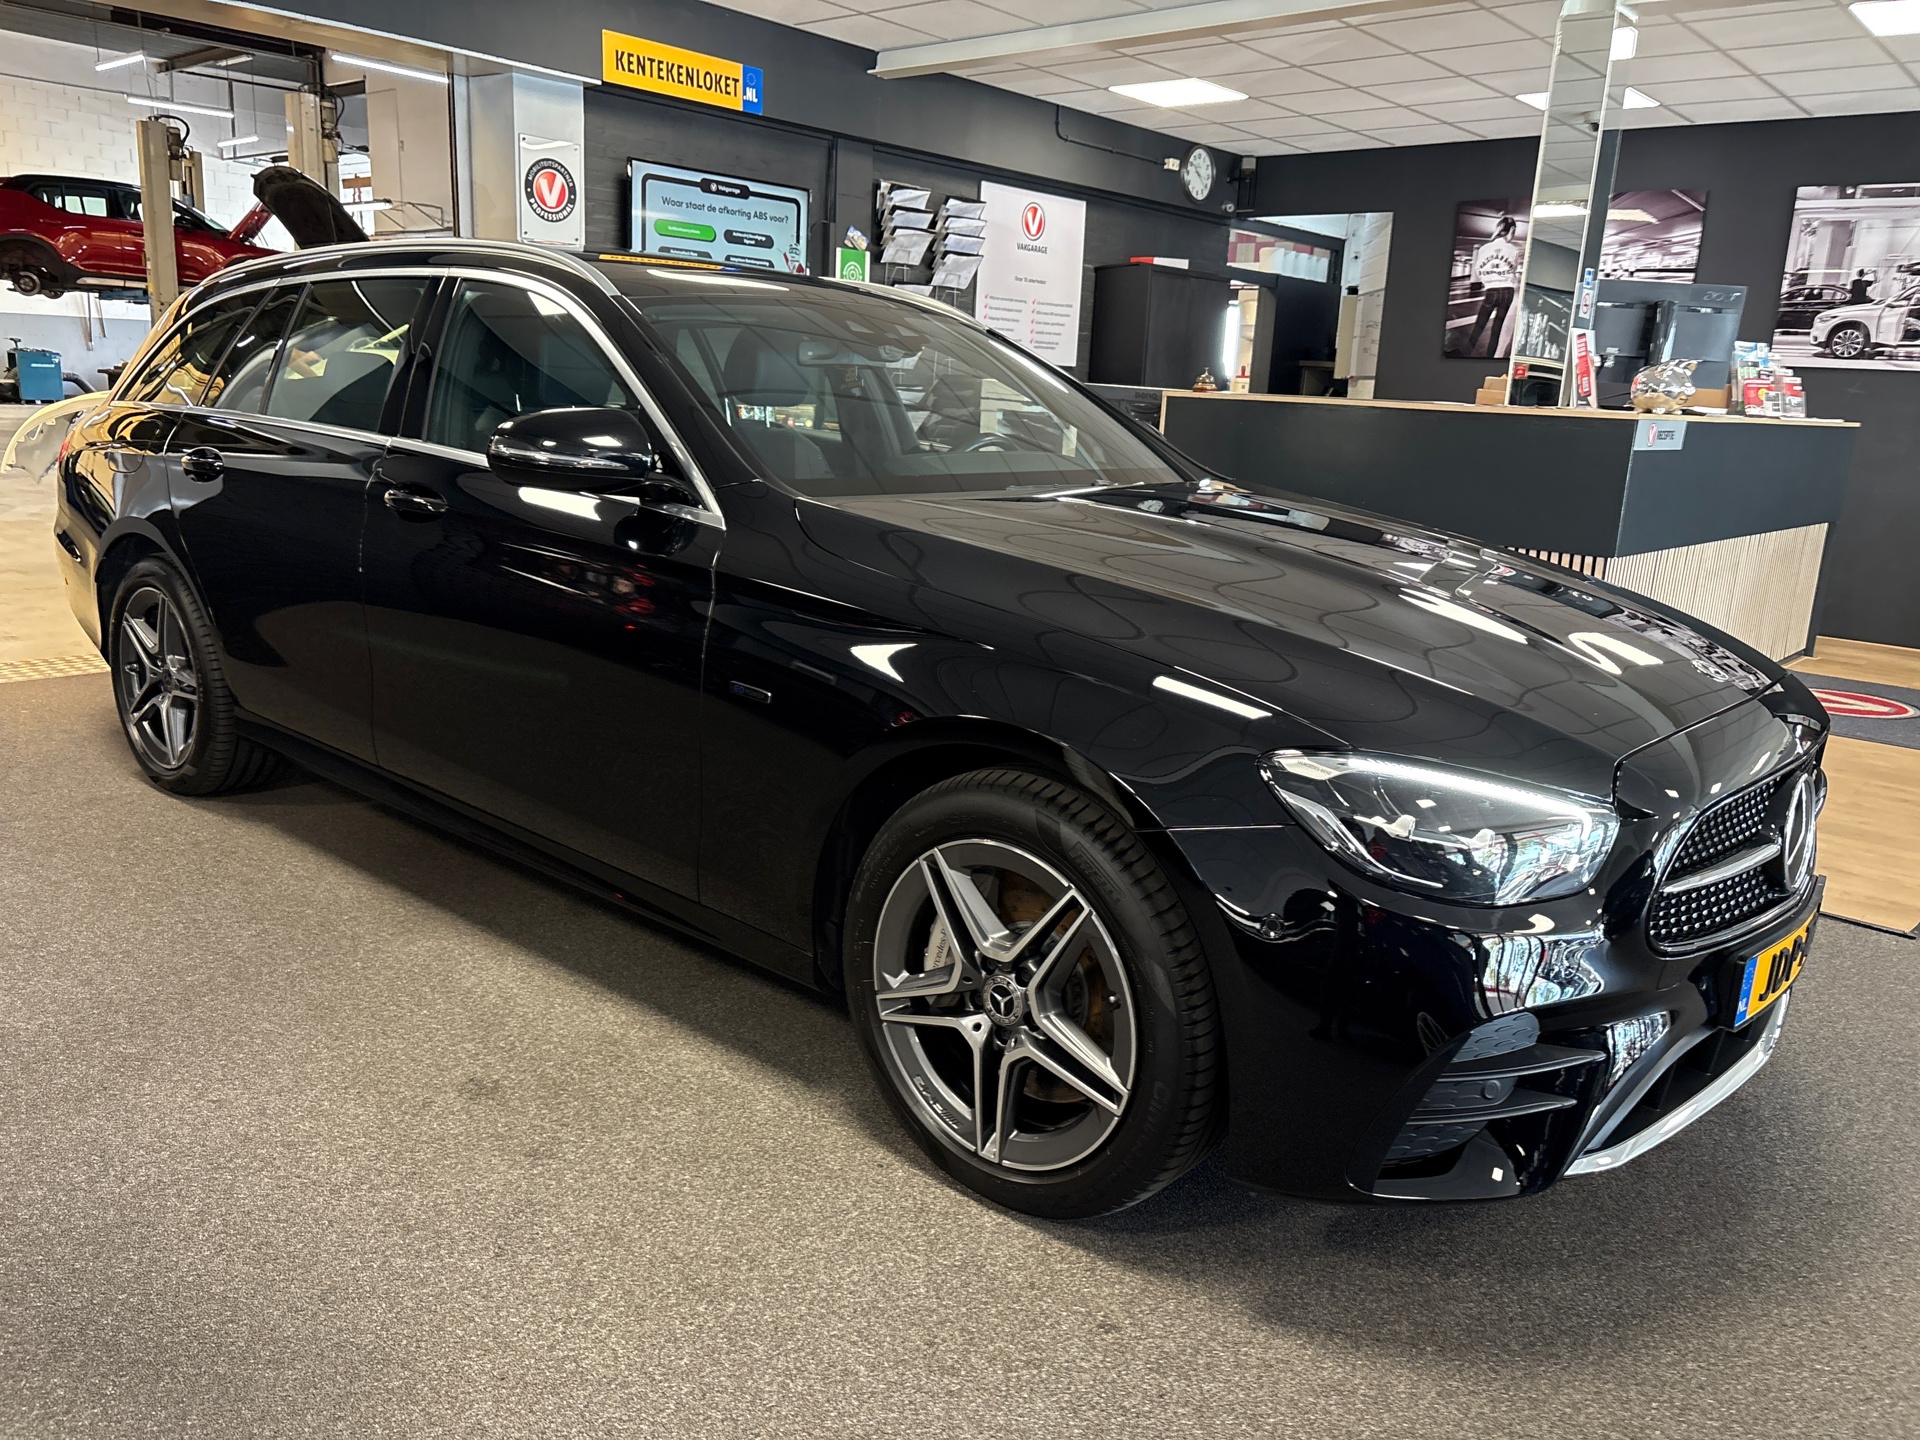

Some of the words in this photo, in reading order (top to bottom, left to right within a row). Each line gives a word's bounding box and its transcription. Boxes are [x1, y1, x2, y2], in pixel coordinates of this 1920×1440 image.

[615, 49, 740, 97] KENTEKENLOKET
[527, 160, 573, 187] MOBILITEITSPARTNER
[529, 198, 573, 221] PROFESSIONAL
[661, 196, 683, 207] Waar
[685, 201, 705, 211] staat
[707, 204, 716, 212] de
[718, 206, 751, 220] afkorting
[753, 211, 768, 220] ABS
[769, 215, 789, 224] voor?
[1016, 242, 1048, 255] VAKGARAGE
